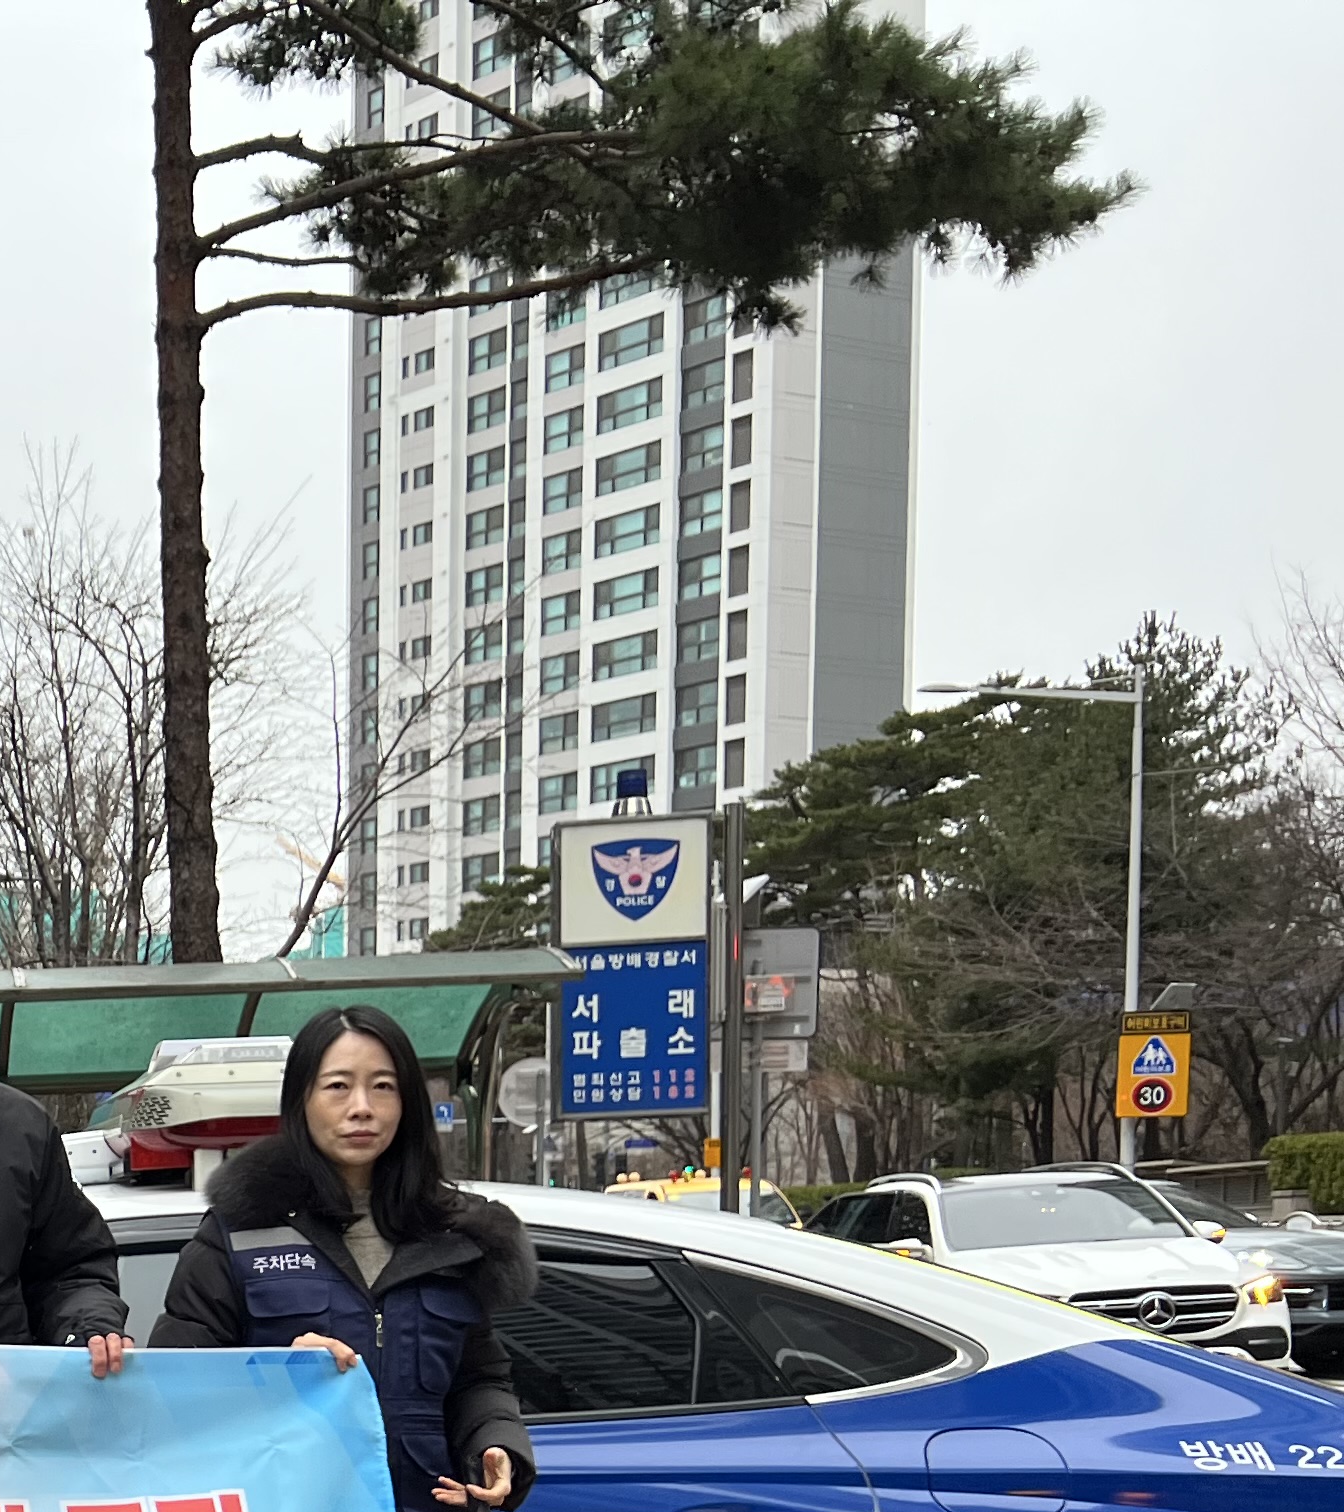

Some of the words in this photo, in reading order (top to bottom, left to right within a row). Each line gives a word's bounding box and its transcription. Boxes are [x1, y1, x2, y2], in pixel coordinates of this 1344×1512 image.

[616, 895, 654, 907] POLICE
[572, 1026, 696, 1060] 파출소
[652, 1067, 695, 1083] 112
[1139, 1086, 1165, 1105] 30
[253, 1252, 316, 1274] 주차단속
[1179, 1440, 1276, 1471] 방배
[1288, 1444, 1344, 1470] 22
